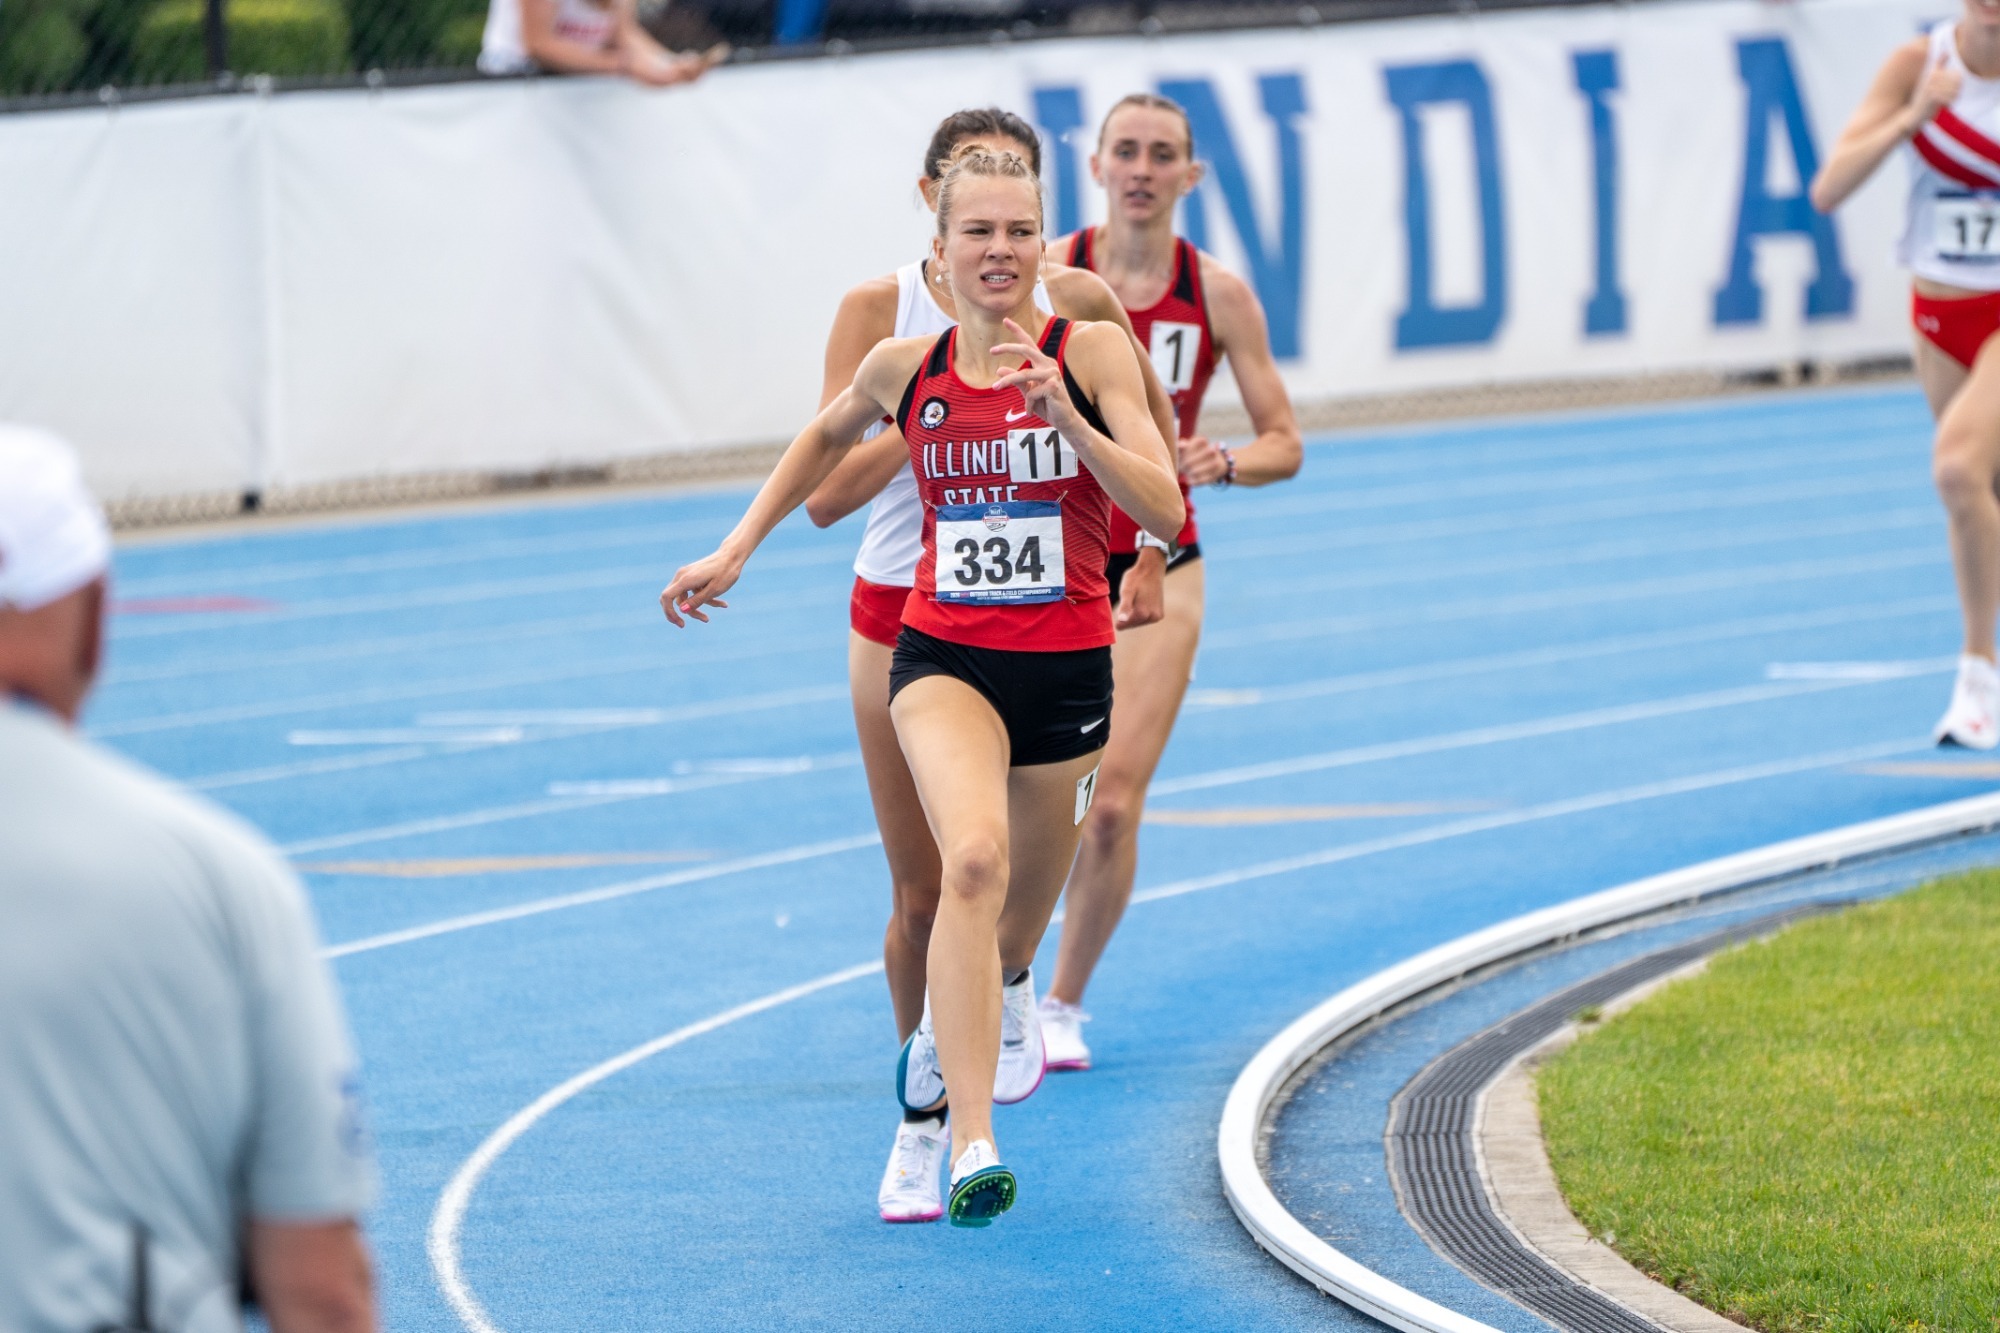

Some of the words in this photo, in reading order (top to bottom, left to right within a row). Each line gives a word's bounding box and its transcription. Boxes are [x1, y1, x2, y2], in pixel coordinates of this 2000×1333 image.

[1033, 22, 1945, 364] INDIA
[1166, 329, 1183, 383] 1
[923, 439, 1008, 479] ILLINO
[1019, 430, 1062, 479] 11
[954, 535, 1045, 586] 334
